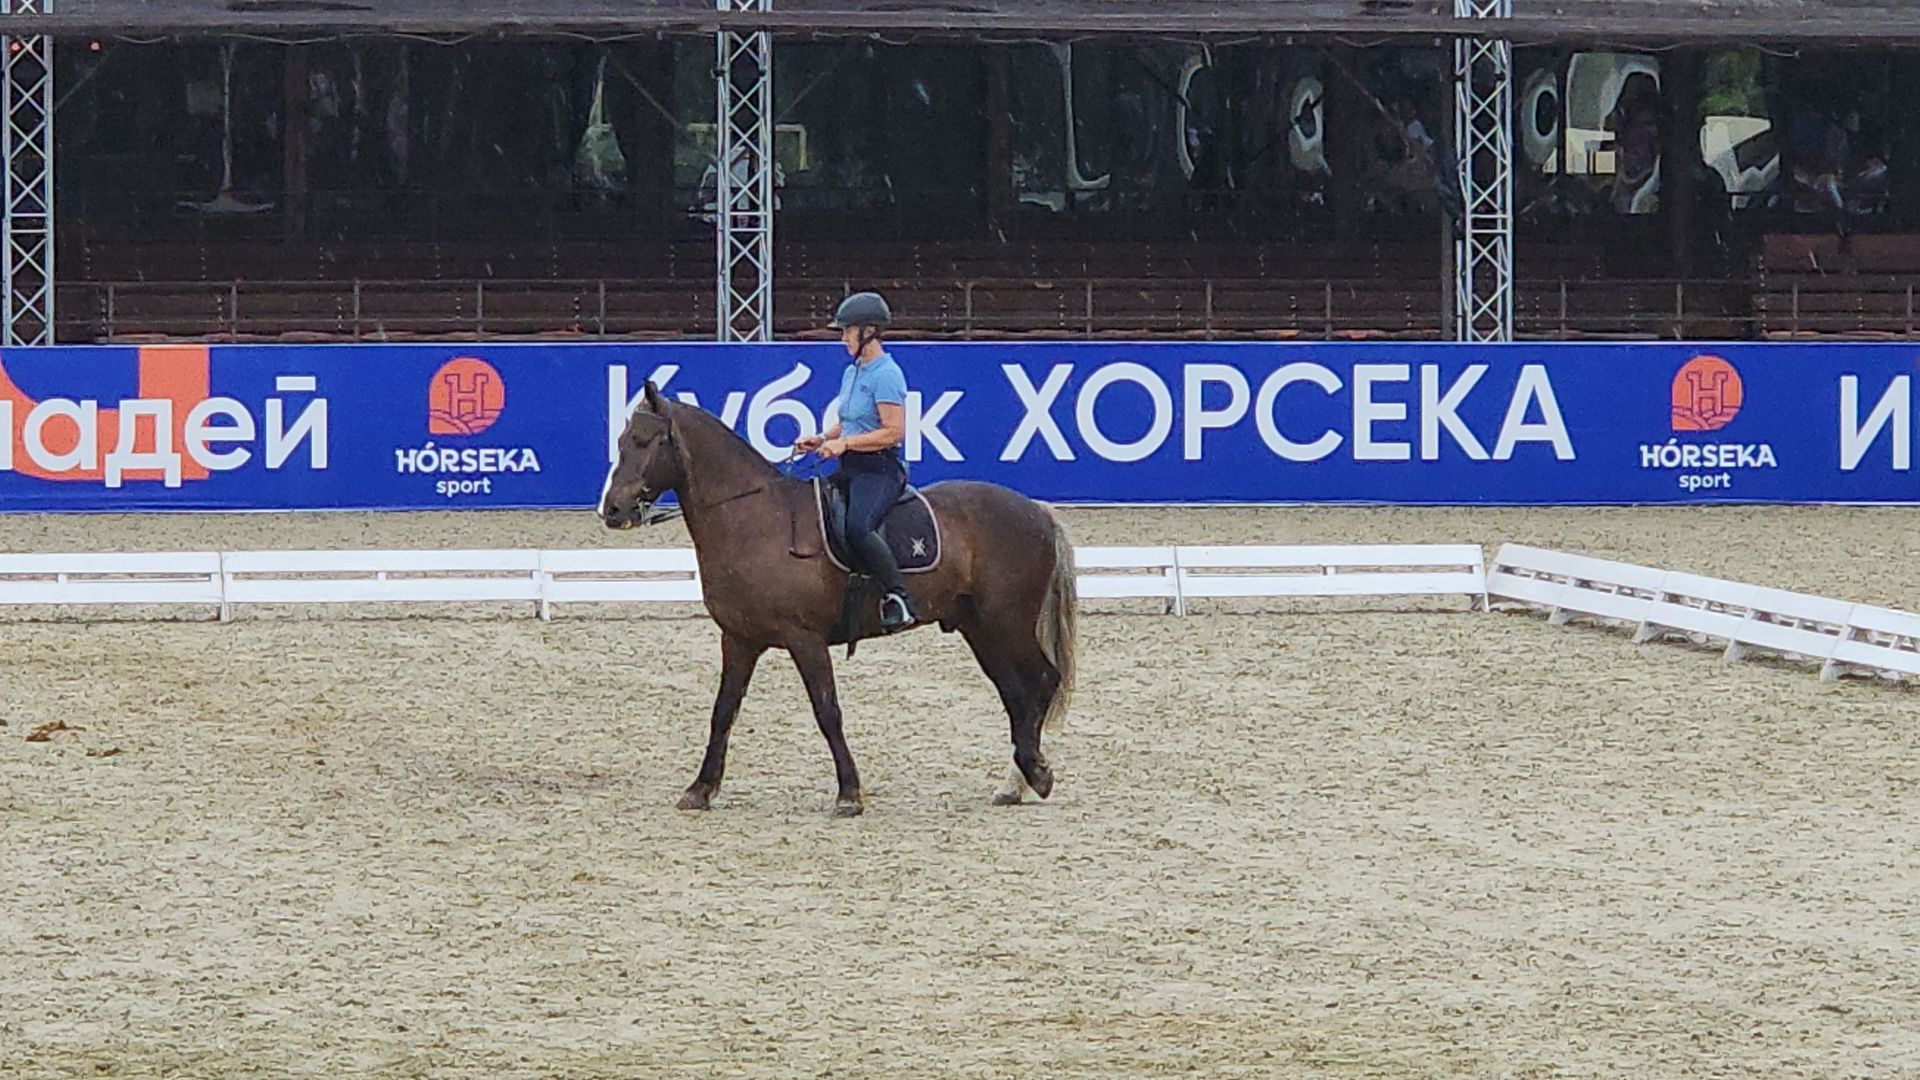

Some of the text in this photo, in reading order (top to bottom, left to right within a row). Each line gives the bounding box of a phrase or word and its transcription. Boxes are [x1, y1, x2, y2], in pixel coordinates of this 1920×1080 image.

[608, 362, 1576, 463] Кбк ХОРСЕКА
[395, 441, 541, 473] HÓRSEKA
[1640, 438, 1777, 468] HÓRSEKA
[436, 477, 492, 498] sport
[1679, 472, 1731, 492] sport
